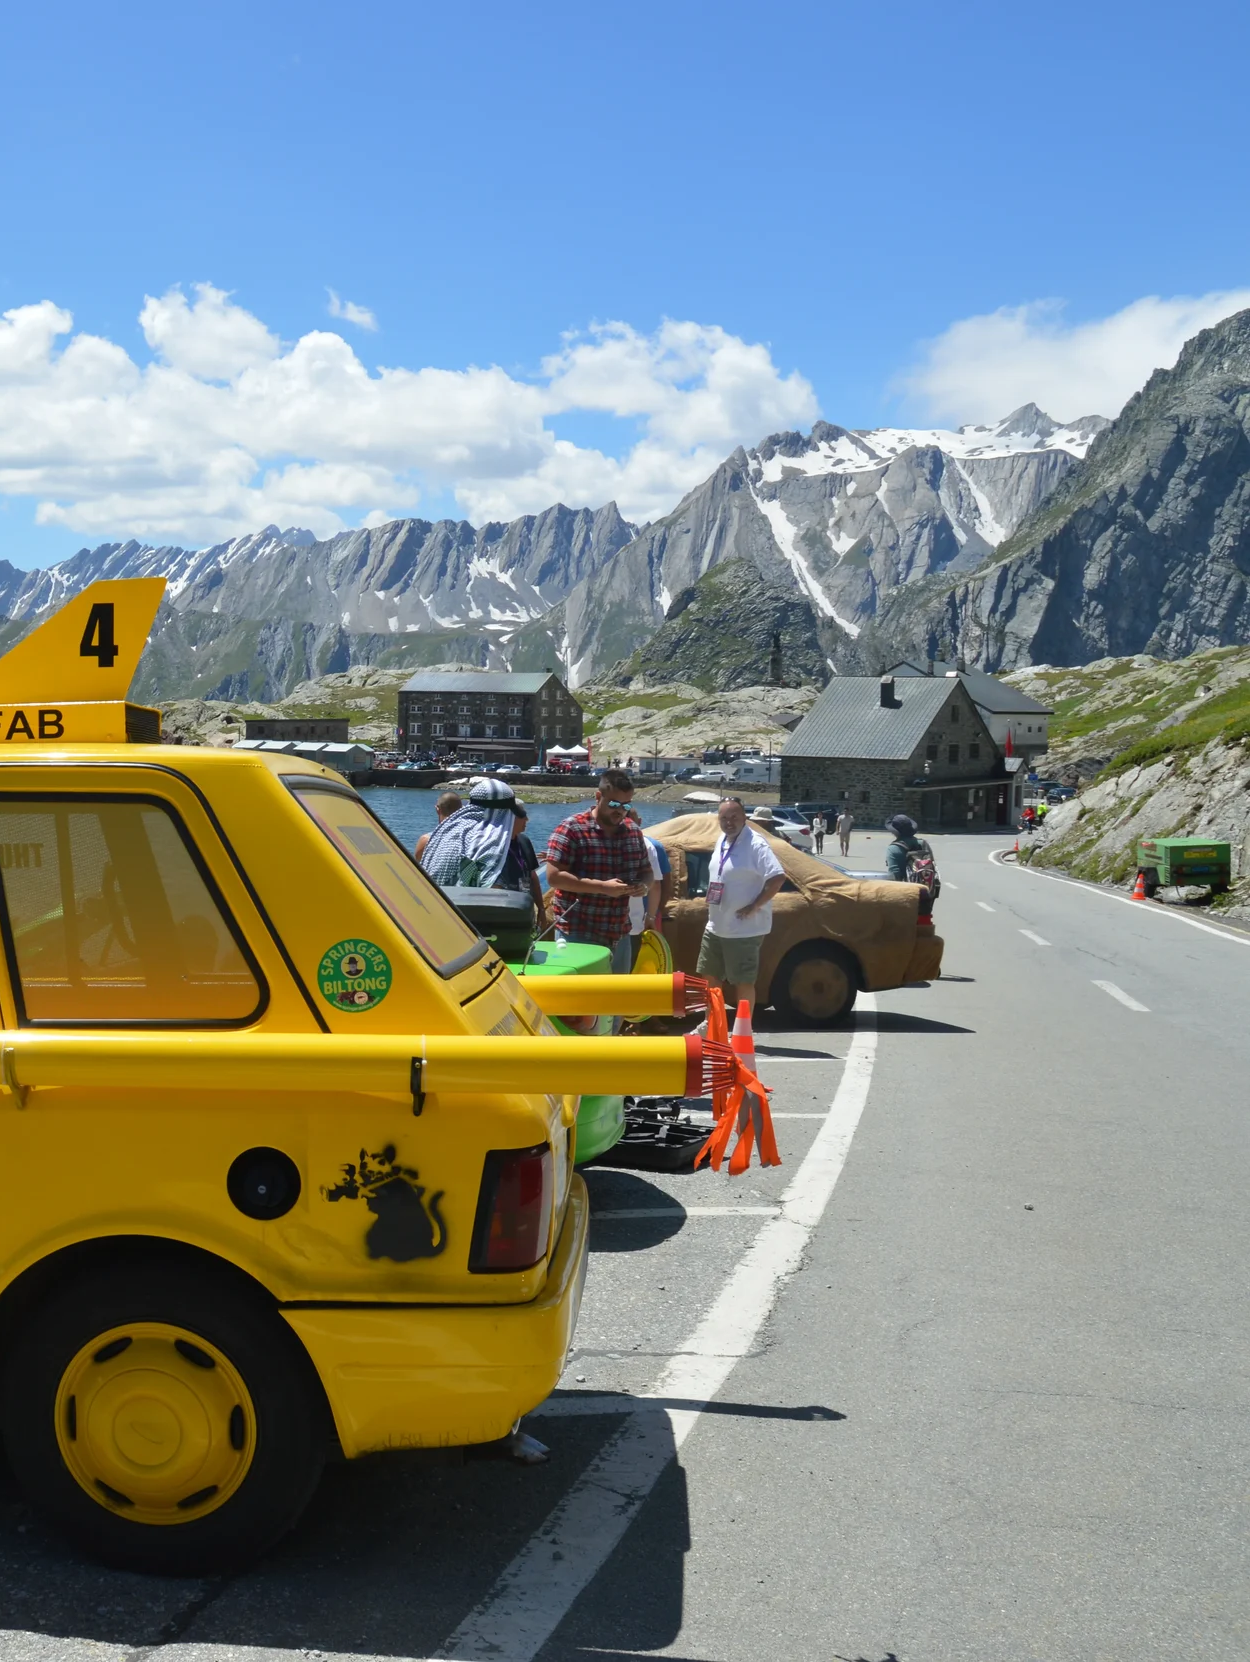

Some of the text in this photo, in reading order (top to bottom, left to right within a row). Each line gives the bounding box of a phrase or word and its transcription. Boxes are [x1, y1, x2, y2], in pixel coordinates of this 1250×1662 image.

[79, 602, 119, 668] 4
[321, 942, 386, 976] SPRINGERS
[323, 976, 387, 995] BILTONG
